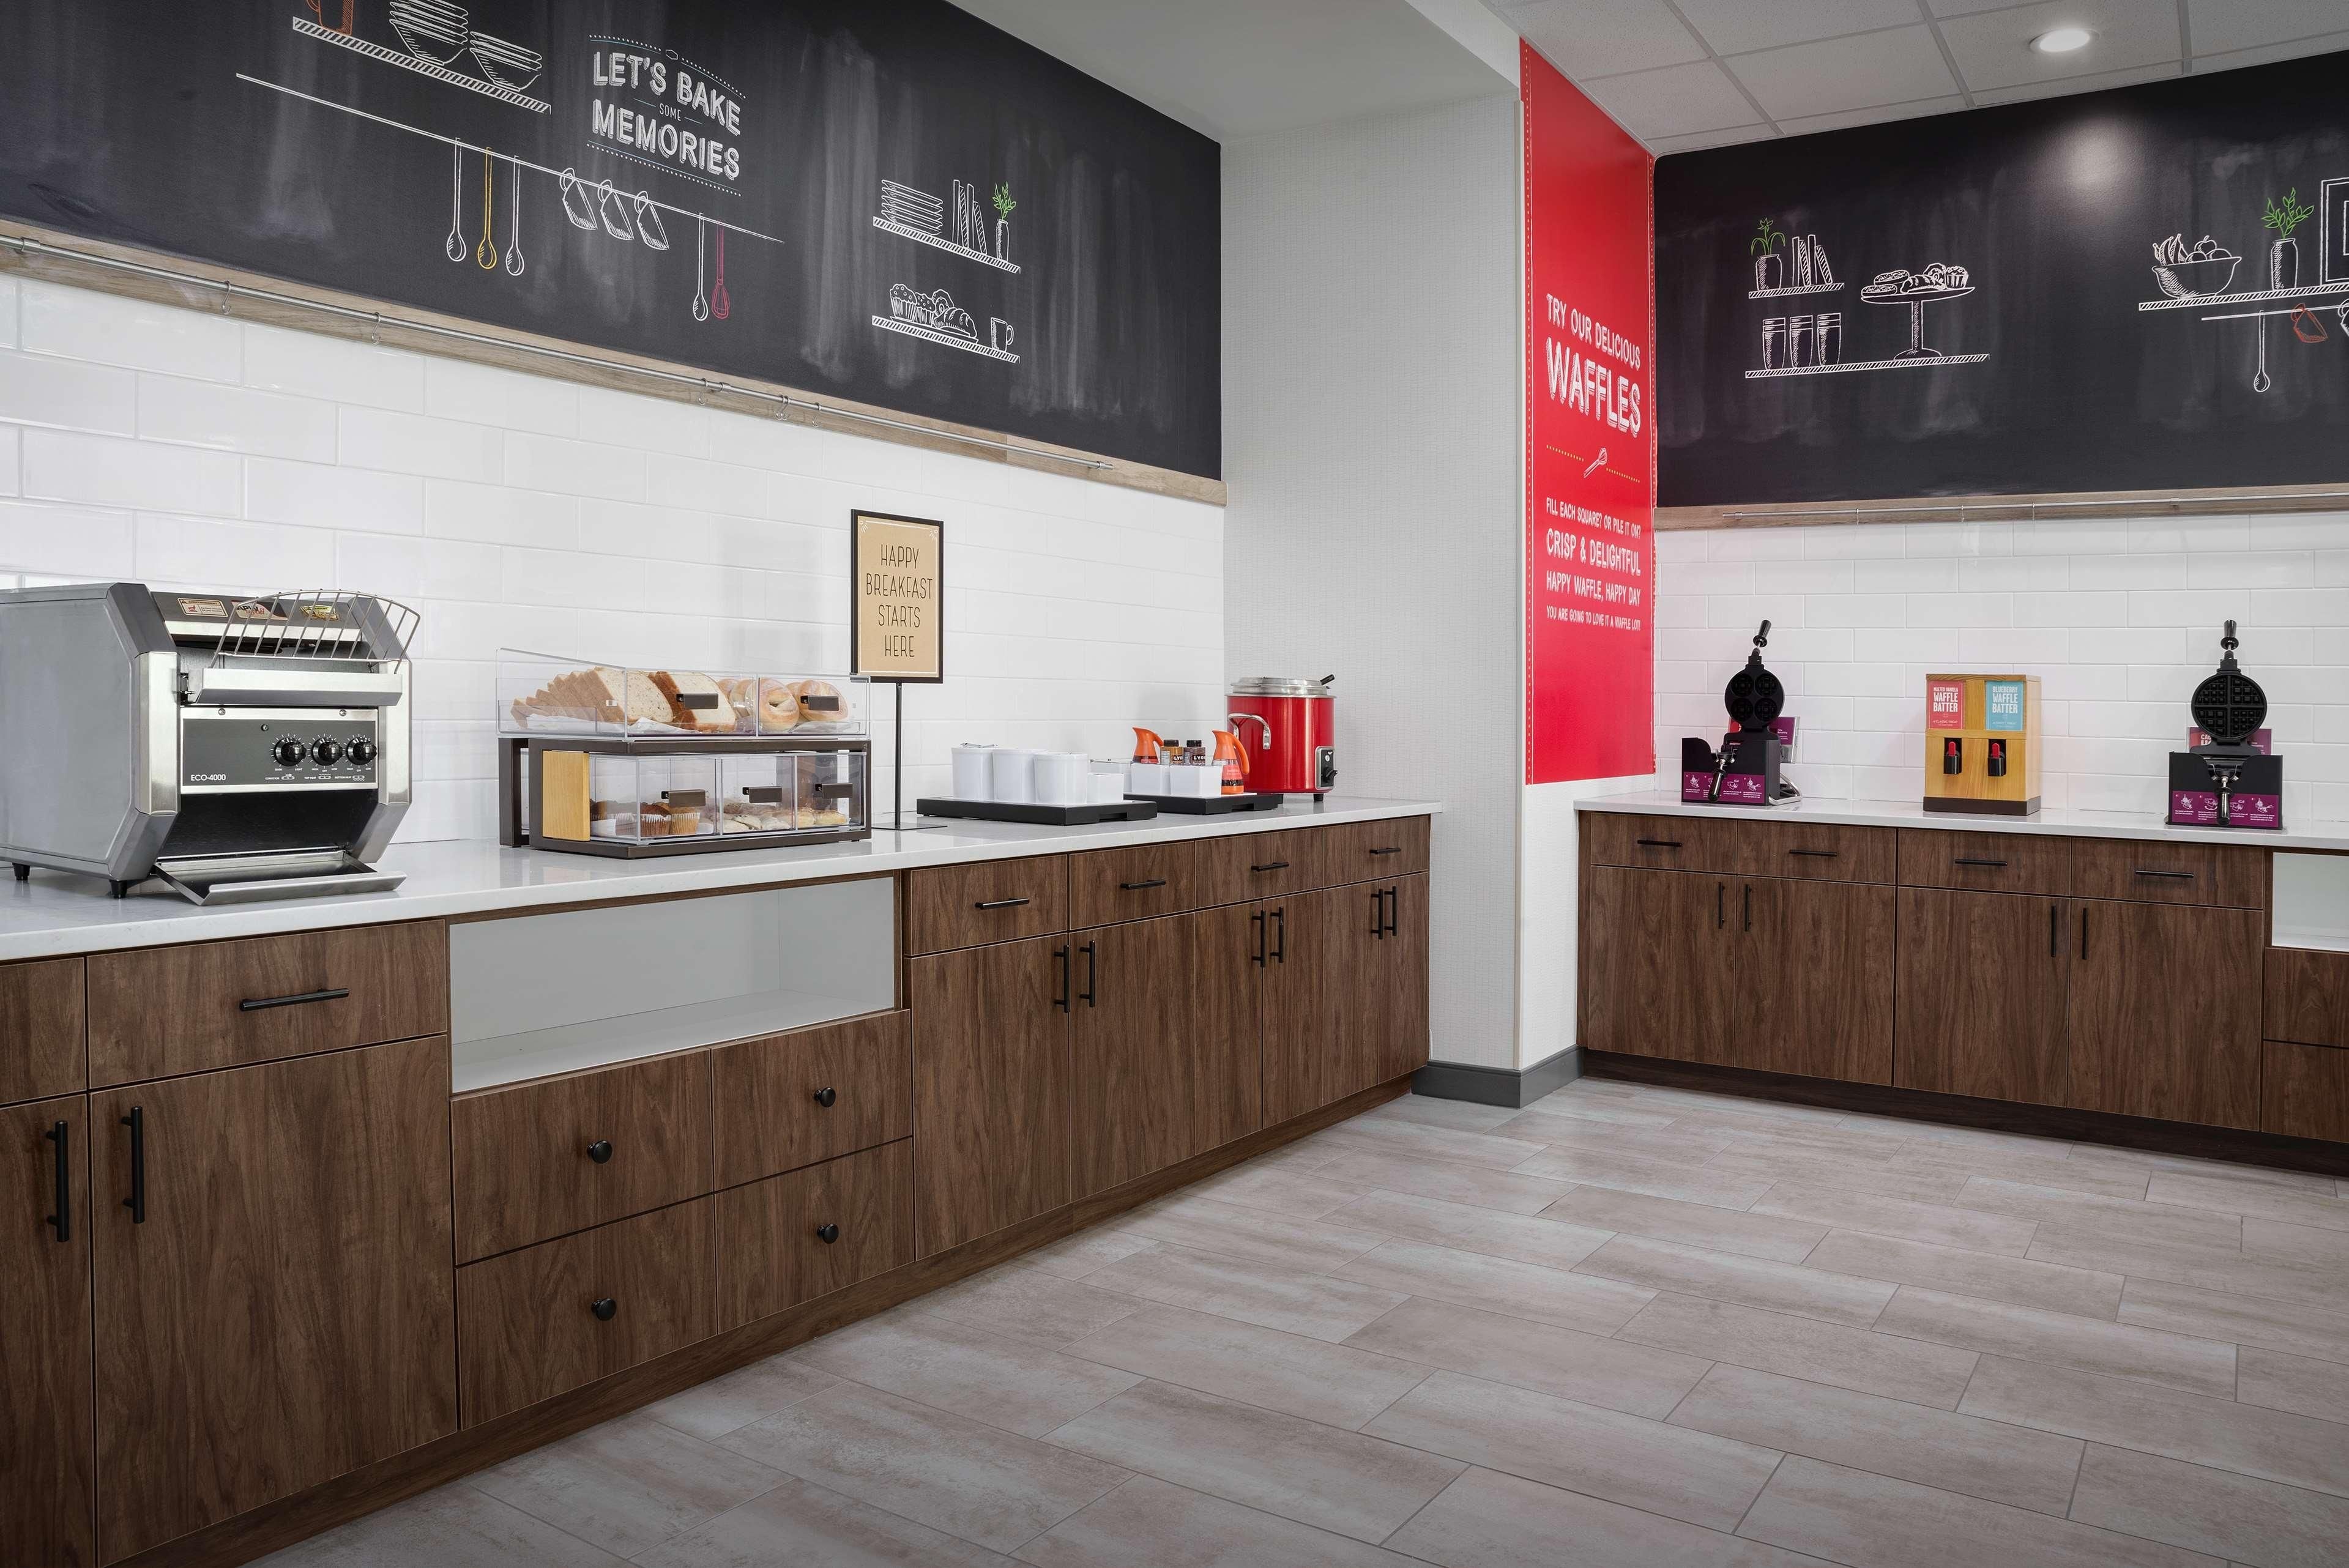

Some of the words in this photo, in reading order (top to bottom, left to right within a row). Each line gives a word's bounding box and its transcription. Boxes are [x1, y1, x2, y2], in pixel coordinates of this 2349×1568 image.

[593, 51, 666, 95] LET'S
[677, 71, 741, 136] BAKE
[659, 103, 682, 121] SOME
[592, 98, 740, 180] MEMORIES
[1546, 293, 1567, 329] TRY
[1570, 308, 1592, 344] OUR
[1595, 322, 1640, 371] DELICIOUS
[1546, 336, 1641, 438] WAFFLES
[1546, 497, 1558, 516] FILL
[1560, 501, 1576, 521] EACH
[1577, 507, 1603, 529] SQUARE?
[1604, 515, 1612, 530] OR
[1613, 518, 1624, 535] PILE
[1625, 521, 1630, 536] IT
[1631, 523, 1641, 540] ON?
[880, 544, 919, 569] HAPPY
[1546, 528, 1577, 562] CRISP
[1580, 537, 1587, 563] &
[1589, 539, 1641, 577] DELIGHTFUL
[866, 573, 933, 600] BREAKFAST
[1546, 570, 1571, 594] HAPPY
[1574, 575, 1603, 602] WAFFLE,
[1606, 583, 1626, 604] HAPPY
[1629, 587, 1641, 607] DAY
[878, 604, 921, 628] STARTS
[1546, 605, 1557, 620] YOU
[1558, 608, 1568, 622] ARE
[1569, 609, 1584, 623] GOING
[1585, 611, 1592, 624] TO
[1593, 612, 1604, 626] LOVE
[1604, 615, 1609, 626] IT
[1610, 615, 1614, 628] A
[1615, 616, 1631, 631] WAFFLE
[885, 635, 915, 658] HERE
[1933, 702, 1958, 712] BATTER
[1934, 692, 1958, 702] WAFFLE
[1992, 703, 2018, 713] BATTER
[1993, 693, 2019, 703] WAFFLE
